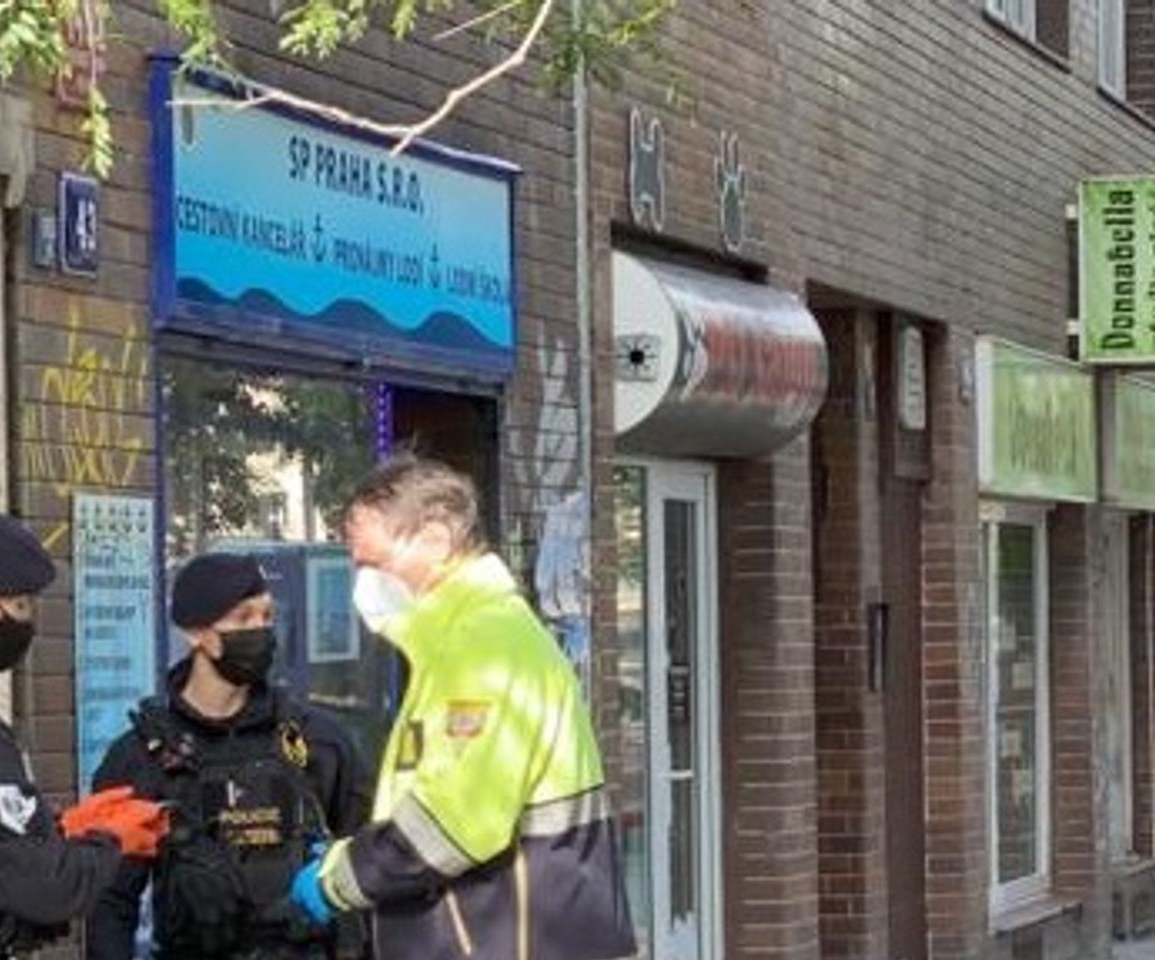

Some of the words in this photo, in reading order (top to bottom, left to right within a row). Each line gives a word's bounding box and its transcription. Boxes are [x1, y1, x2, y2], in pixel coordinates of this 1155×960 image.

[289, 134, 310, 182] SP
[315, 142, 373, 201] PRAHA
[1100, 189, 1135, 350] Donnabella
